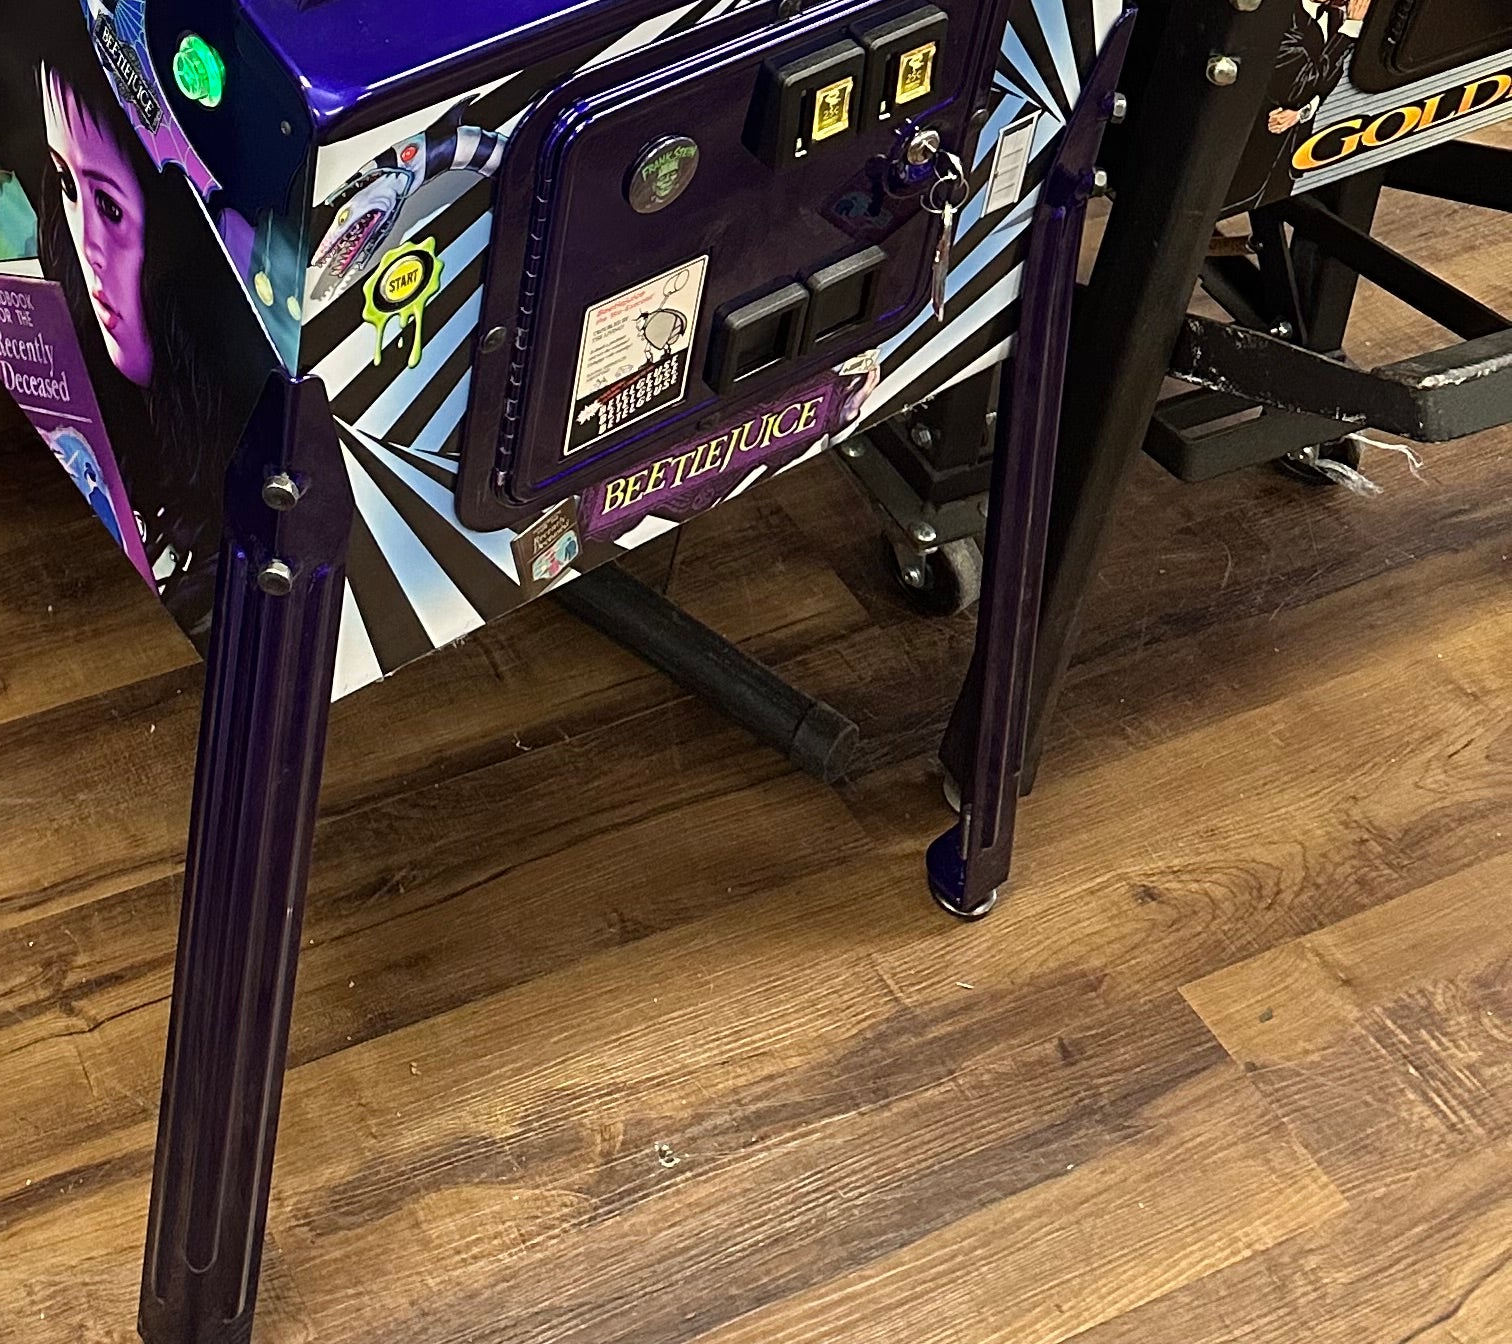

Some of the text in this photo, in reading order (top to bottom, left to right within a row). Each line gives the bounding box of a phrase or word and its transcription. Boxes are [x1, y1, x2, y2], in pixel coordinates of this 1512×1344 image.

[101, 25, 156, 118] BEETLEJUICE
[389, 269, 419, 293] START
[14, 309, 35, 328] THE
[0, 360, 70, 402] Deceased
[598, 374, 678, 435] BETELGEUSE
[599, 354, 679, 417] BETELGEUSE
[599, 364, 679, 425] BETELGEUSE
[601, 397, 824, 516] BEETLEJUICE
